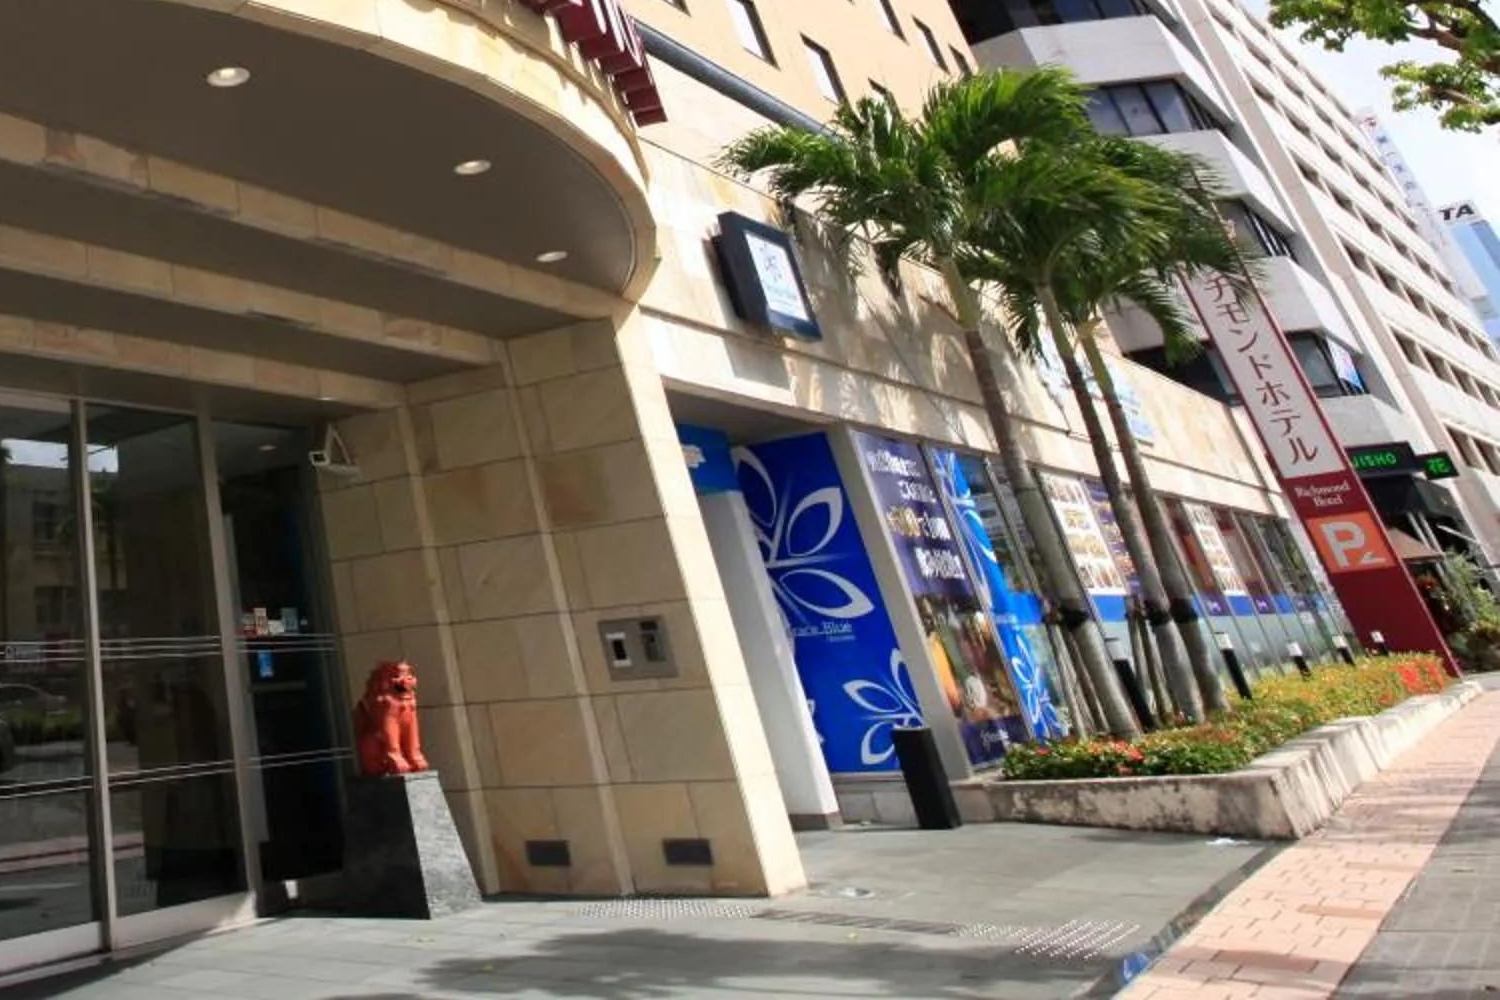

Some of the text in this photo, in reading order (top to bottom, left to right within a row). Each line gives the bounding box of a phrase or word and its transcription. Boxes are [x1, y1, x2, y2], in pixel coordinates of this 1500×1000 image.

[1204, 271, 1319, 465] チモンドホテル
[1320, 520, 1366, 568] P
